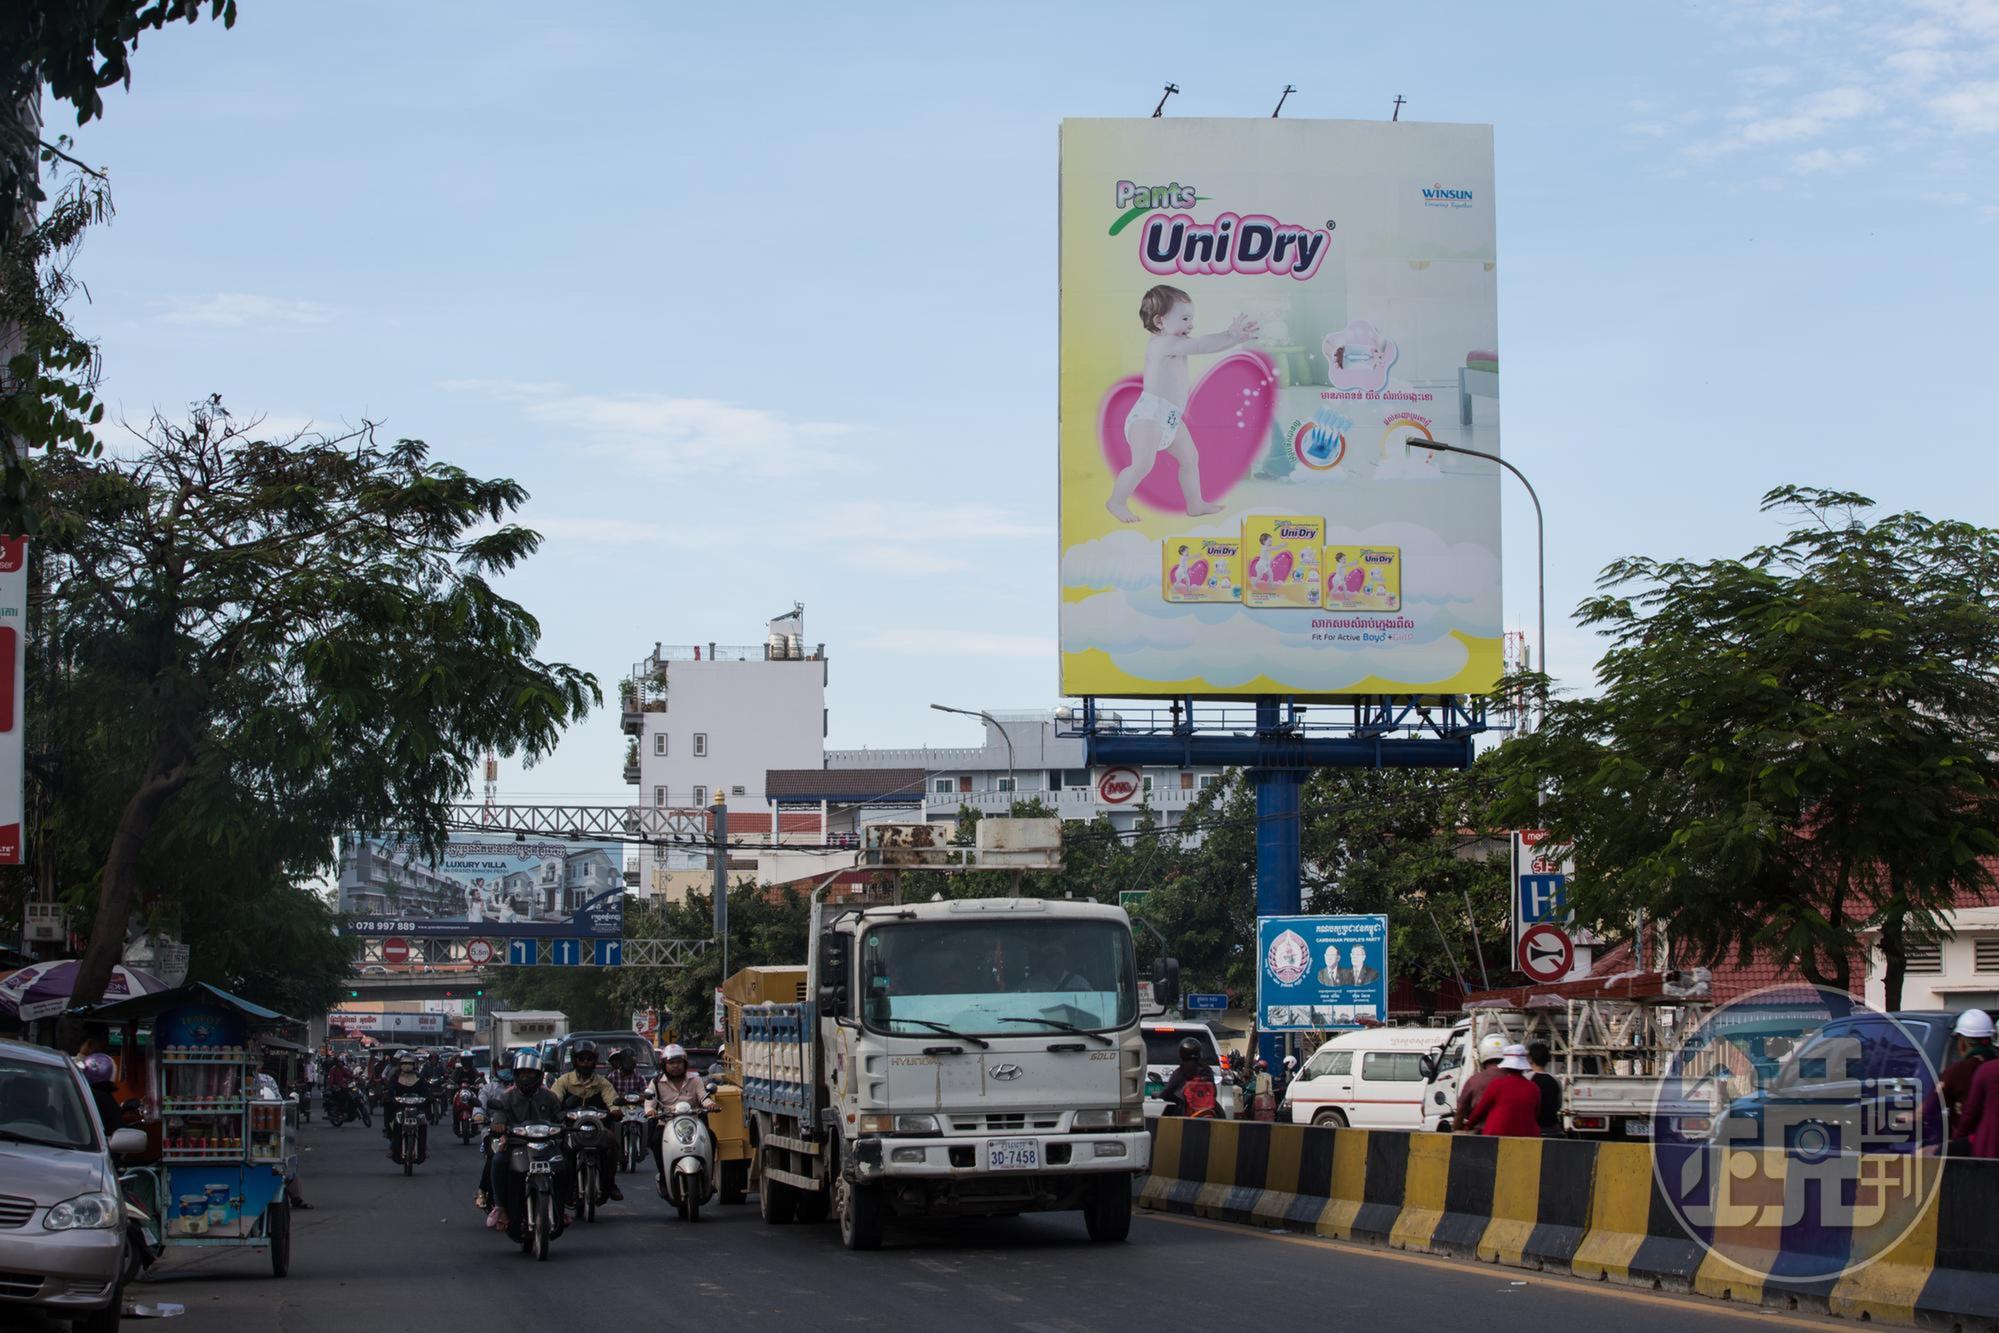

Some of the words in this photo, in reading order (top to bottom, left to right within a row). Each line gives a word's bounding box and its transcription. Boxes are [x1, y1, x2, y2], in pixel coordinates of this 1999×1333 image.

[1115, 180, 1198, 209] Pants
[1421, 188, 1473, 200] WINSUN
[1311, 633, 1322, 641] Fit
[1324, 633, 1336, 641] For
[1337, 633, 1361, 641] Active
[445, 861, 481, 869] LUXURY
[482, 861, 507, 869] VILLA
[356, 921, 375, 930] 078
[377, 922, 395, 931] 997
[397, 922, 416, 931] 889
[1088, 1052, 1117, 1062] GOLD
[991, 1151, 1036, 1165] 3D-7458
